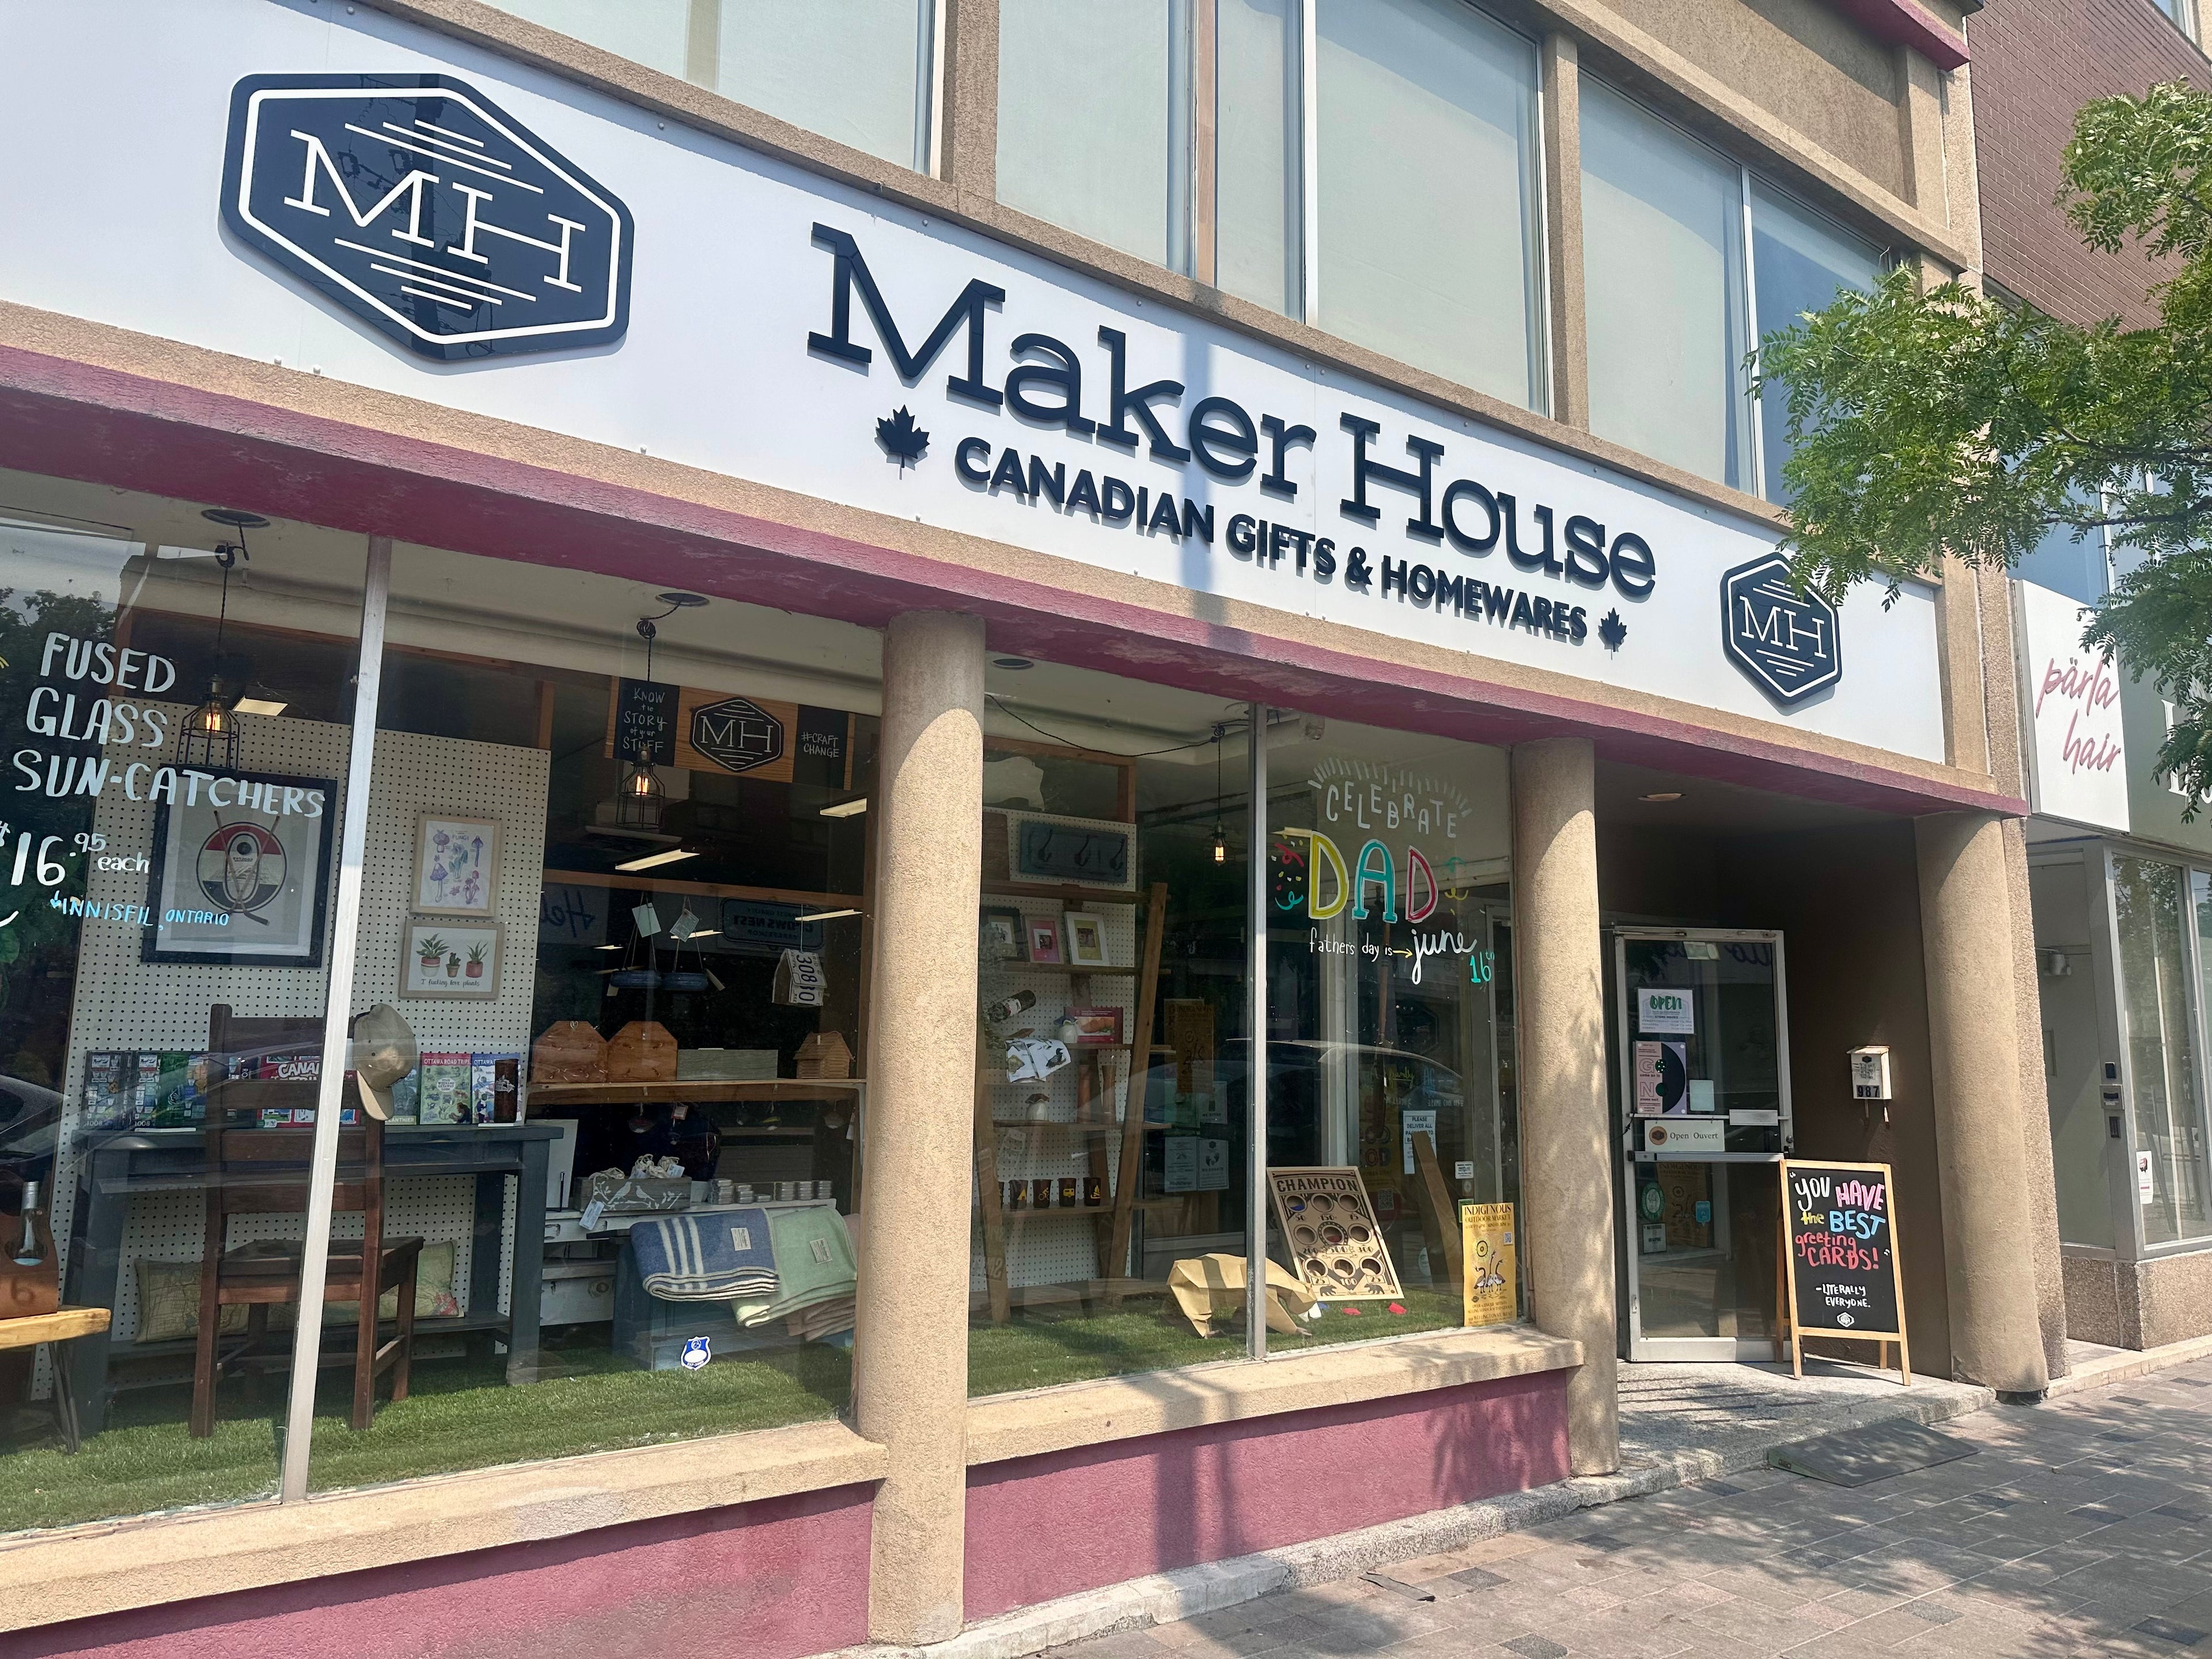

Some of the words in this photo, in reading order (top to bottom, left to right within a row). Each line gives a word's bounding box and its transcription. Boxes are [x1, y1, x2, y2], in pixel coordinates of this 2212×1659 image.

[283, 129, 586, 293] MH
[808, 221, 1316, 495] Maker
[1340, 412, 1656, 596] House
[955, 436, 1215, 543] CANADIAN
[1227, 513, 1336, 576] GIFTS
[1347, 546, 1373, 585] &
[1381, 555, 1588, 640] HOMEWARES
[1739, 595, 1827, 658] MH
[40, 632, 175, 692] FUSED
[634, 688, 665, 703] KNOW
[2036, 654, 2119, 719] pärla
[26, 687, 168, 749] GLASS
[624, 711, 667, 731] STORY
[630, 726, 638, 736] of
[700, 716, 772, 752] MH
[801, 732, 839, 746] #CRAFT
[2063, 709, 2120, 774] hair
[804, 743, 839, 758] CHANGE
[13, 749, 326, 818] SUN-CATCHERS
[1327, 781, 1457, 838] CELEBRATE
[98, 852, 150, 873] each
[1309, 830, 1438, 923] DAD
[165, 908, 229, 926] ONTARIO
[1362, 933, 1379, 962] day
[1385, 946, 1393, 956] is
[1411, 929, 1478, 985] june
[1650, 995, 1682, 1010] OPEN
[1858, 1085, 1878, 1097] 987
[1670, 1132, 1689, 1141] Open
[1277, 1178, 1358, 1192] CHAMPION
[1835, 1180, 1885, 1211] HAVE
[1465, 1204, 1512, 1215] INDIGENOUS
[1800, 1211, 1824, 1225] the
[1829, 1210, 1886, 1239] BEST
[1795, 1231, 1857, 1257] greeting
